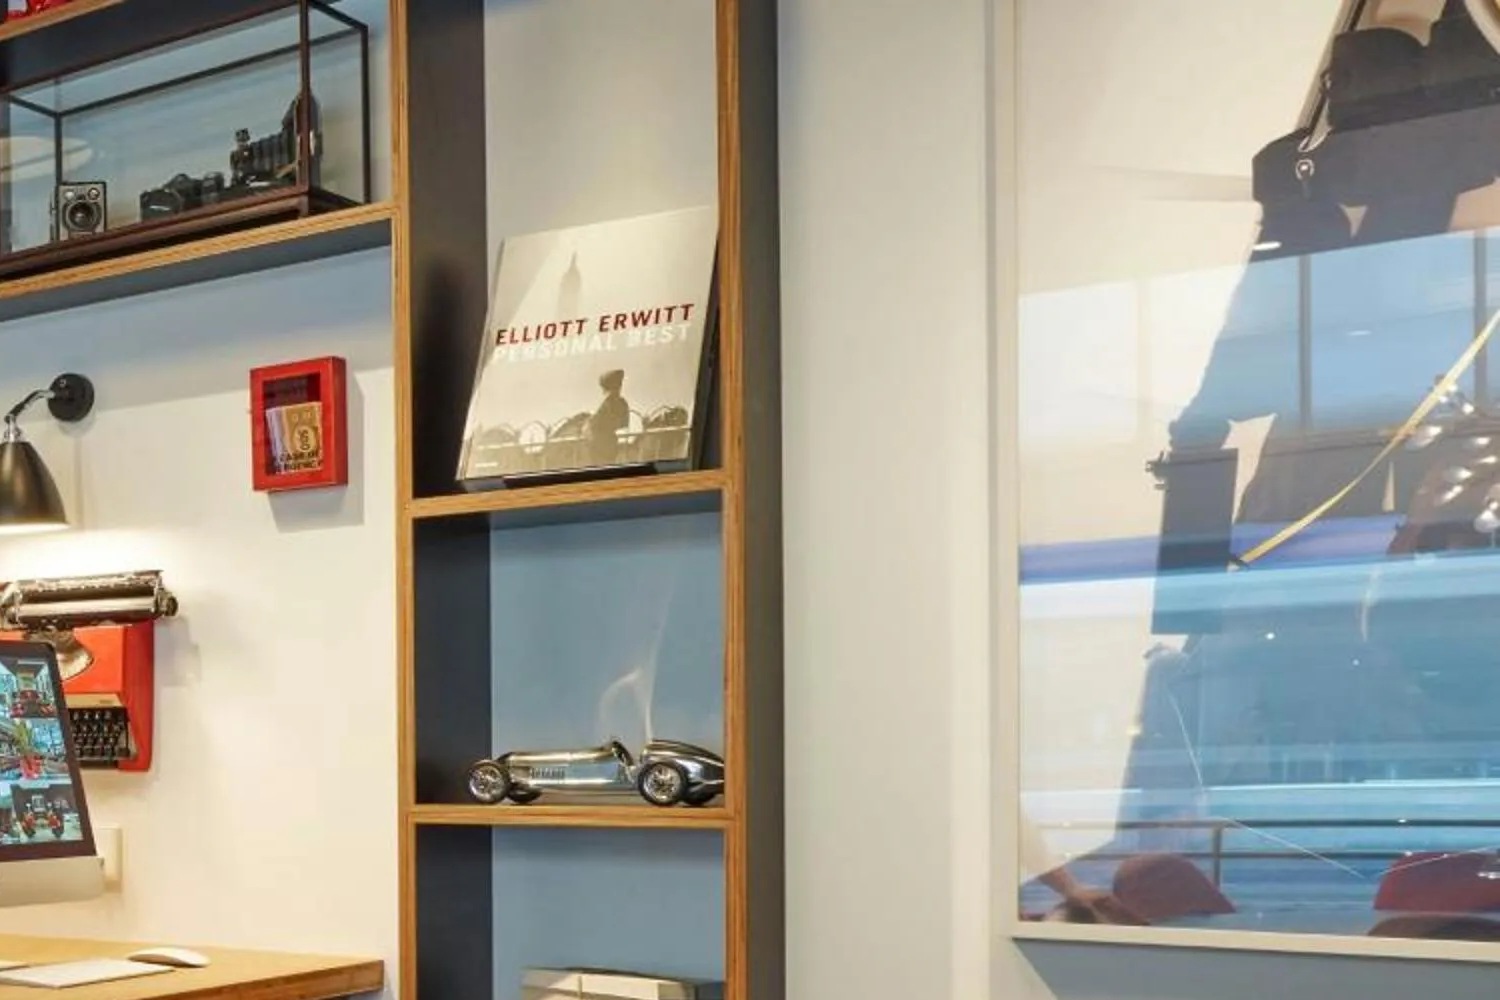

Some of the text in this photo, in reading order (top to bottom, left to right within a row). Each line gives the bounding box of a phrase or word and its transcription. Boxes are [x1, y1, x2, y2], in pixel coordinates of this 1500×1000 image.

[490, 323, 692, 365] PERSONAL BEST
[494, 303, 695, 346] ELLIOTT ERWITT
